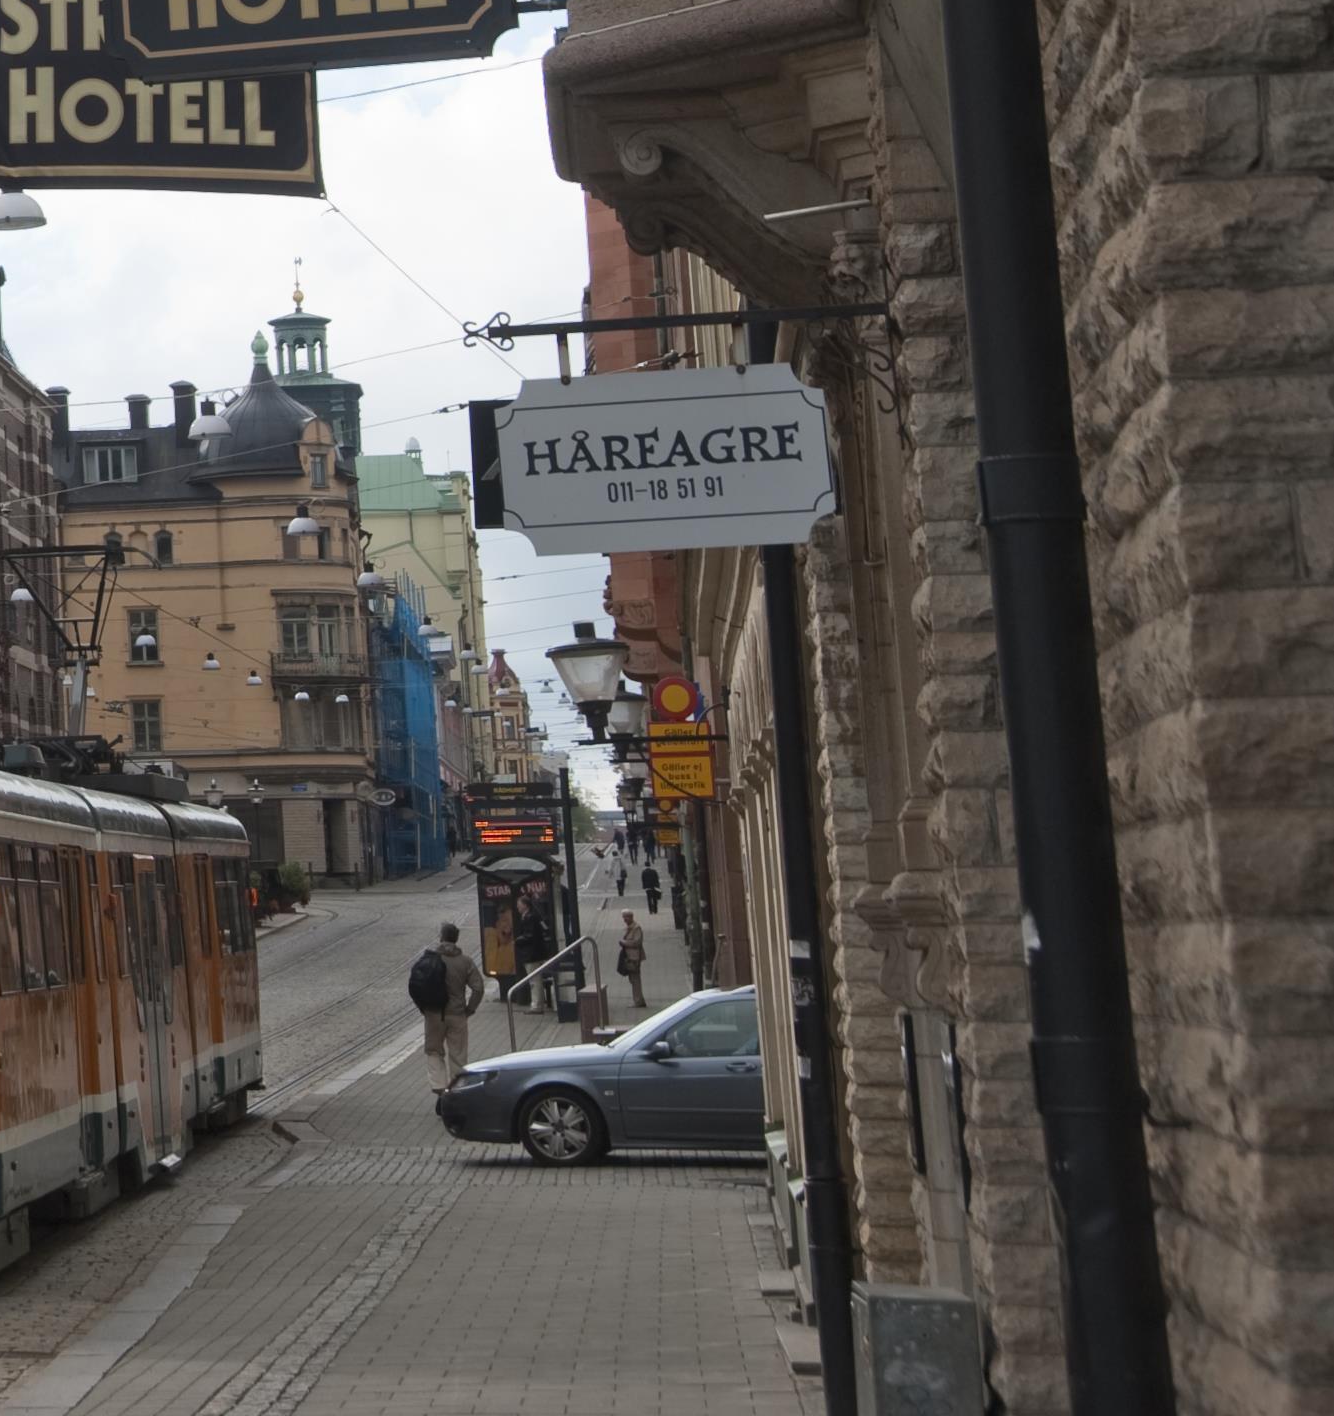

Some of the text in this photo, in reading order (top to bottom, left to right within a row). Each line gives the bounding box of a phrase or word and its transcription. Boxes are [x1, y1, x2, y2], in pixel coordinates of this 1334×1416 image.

[8, 65, 276, 147] HOTELL
[523, 421, 803, 476] HÅRFAGRE
[607, 476, 724, 503] 011-18 51 91
